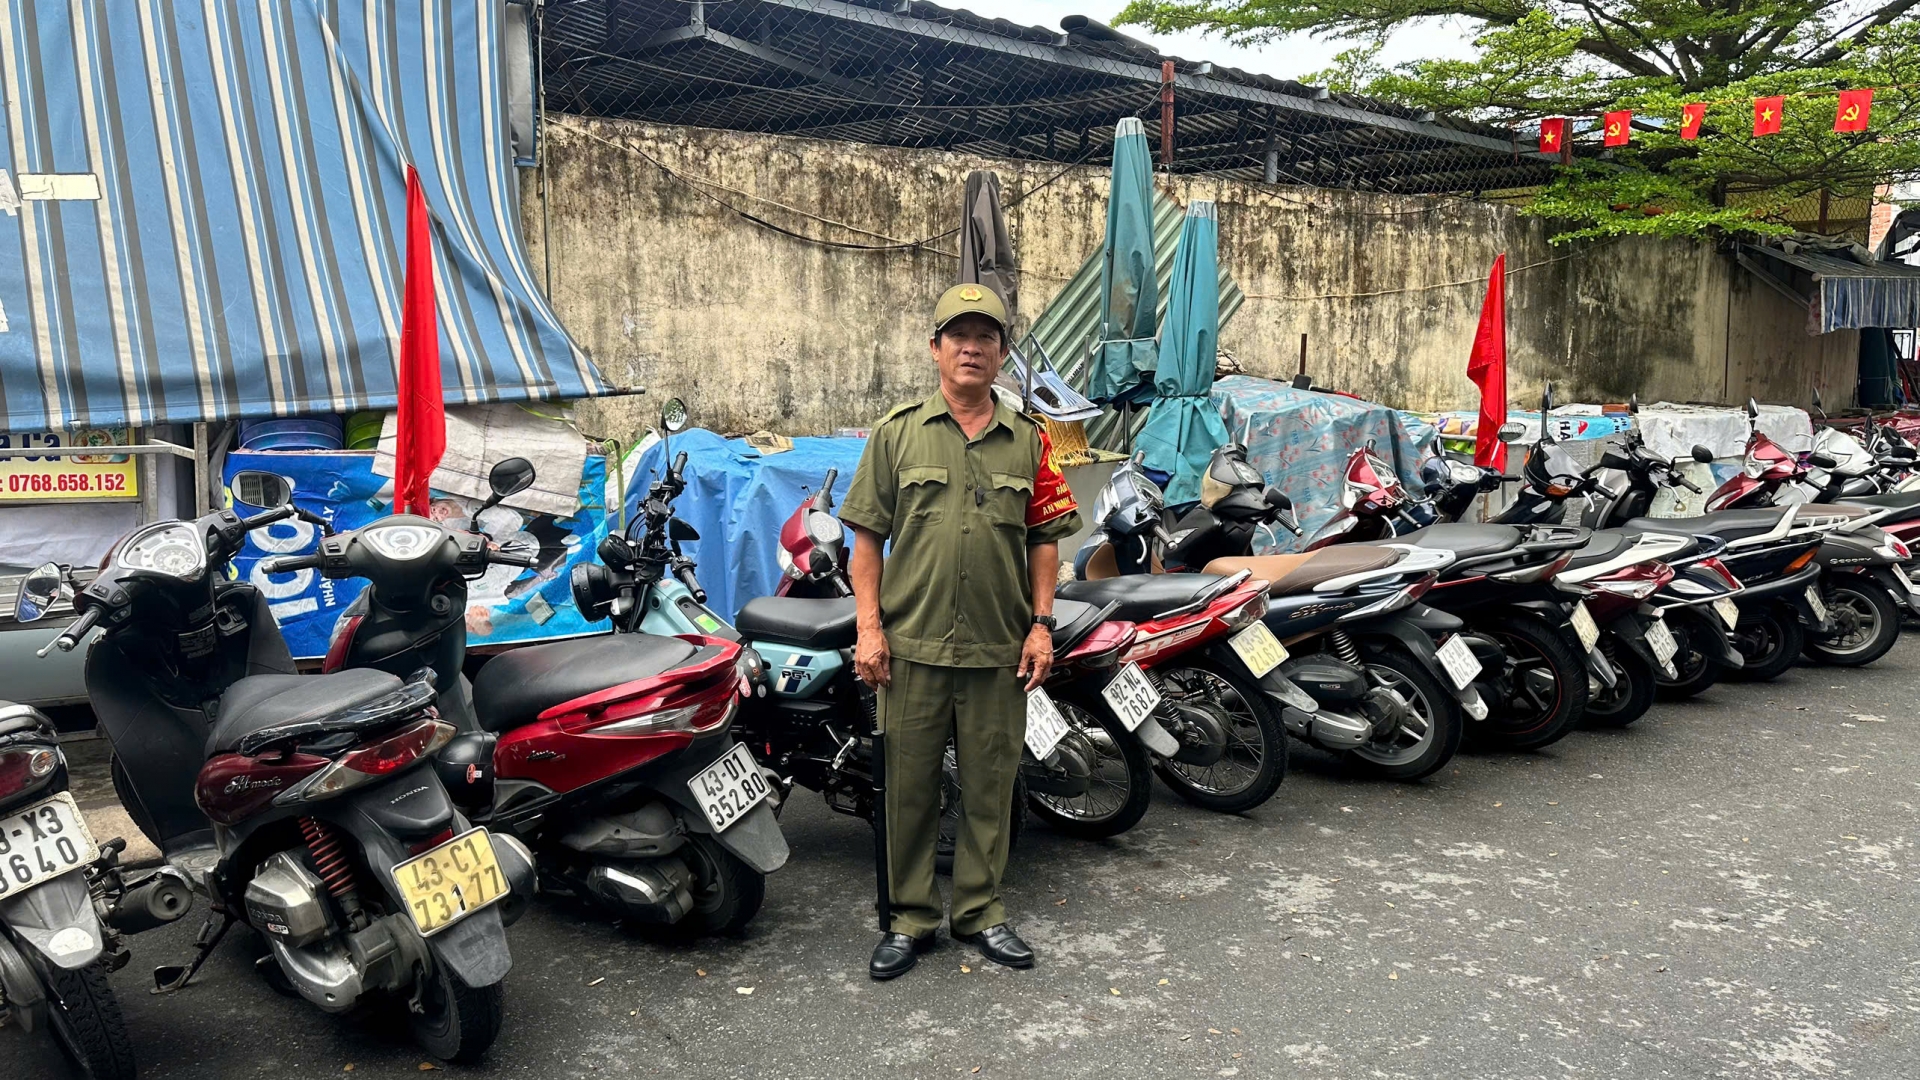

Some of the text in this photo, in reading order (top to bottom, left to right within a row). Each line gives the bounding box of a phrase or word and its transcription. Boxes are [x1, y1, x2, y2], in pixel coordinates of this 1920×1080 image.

[9, 473, 125, 492] 0768.658.152
[781, 669, 812, 681] PG-1
[1250, 643, 1283, 672] 2462
[1110, 670, 1142, 705] 92-N4
[1122, 687, 1155, 725] 7682
[1028, 711, 1065, 755] 381.28
[703, 752, 748, 797] 43-D1
[390, 785, 430, 805] HONDA
[708, 771, 767, 827] 352.80
[413, 838, 481, 892] 43-C1
[414, 864, 502, 930] 731.77
